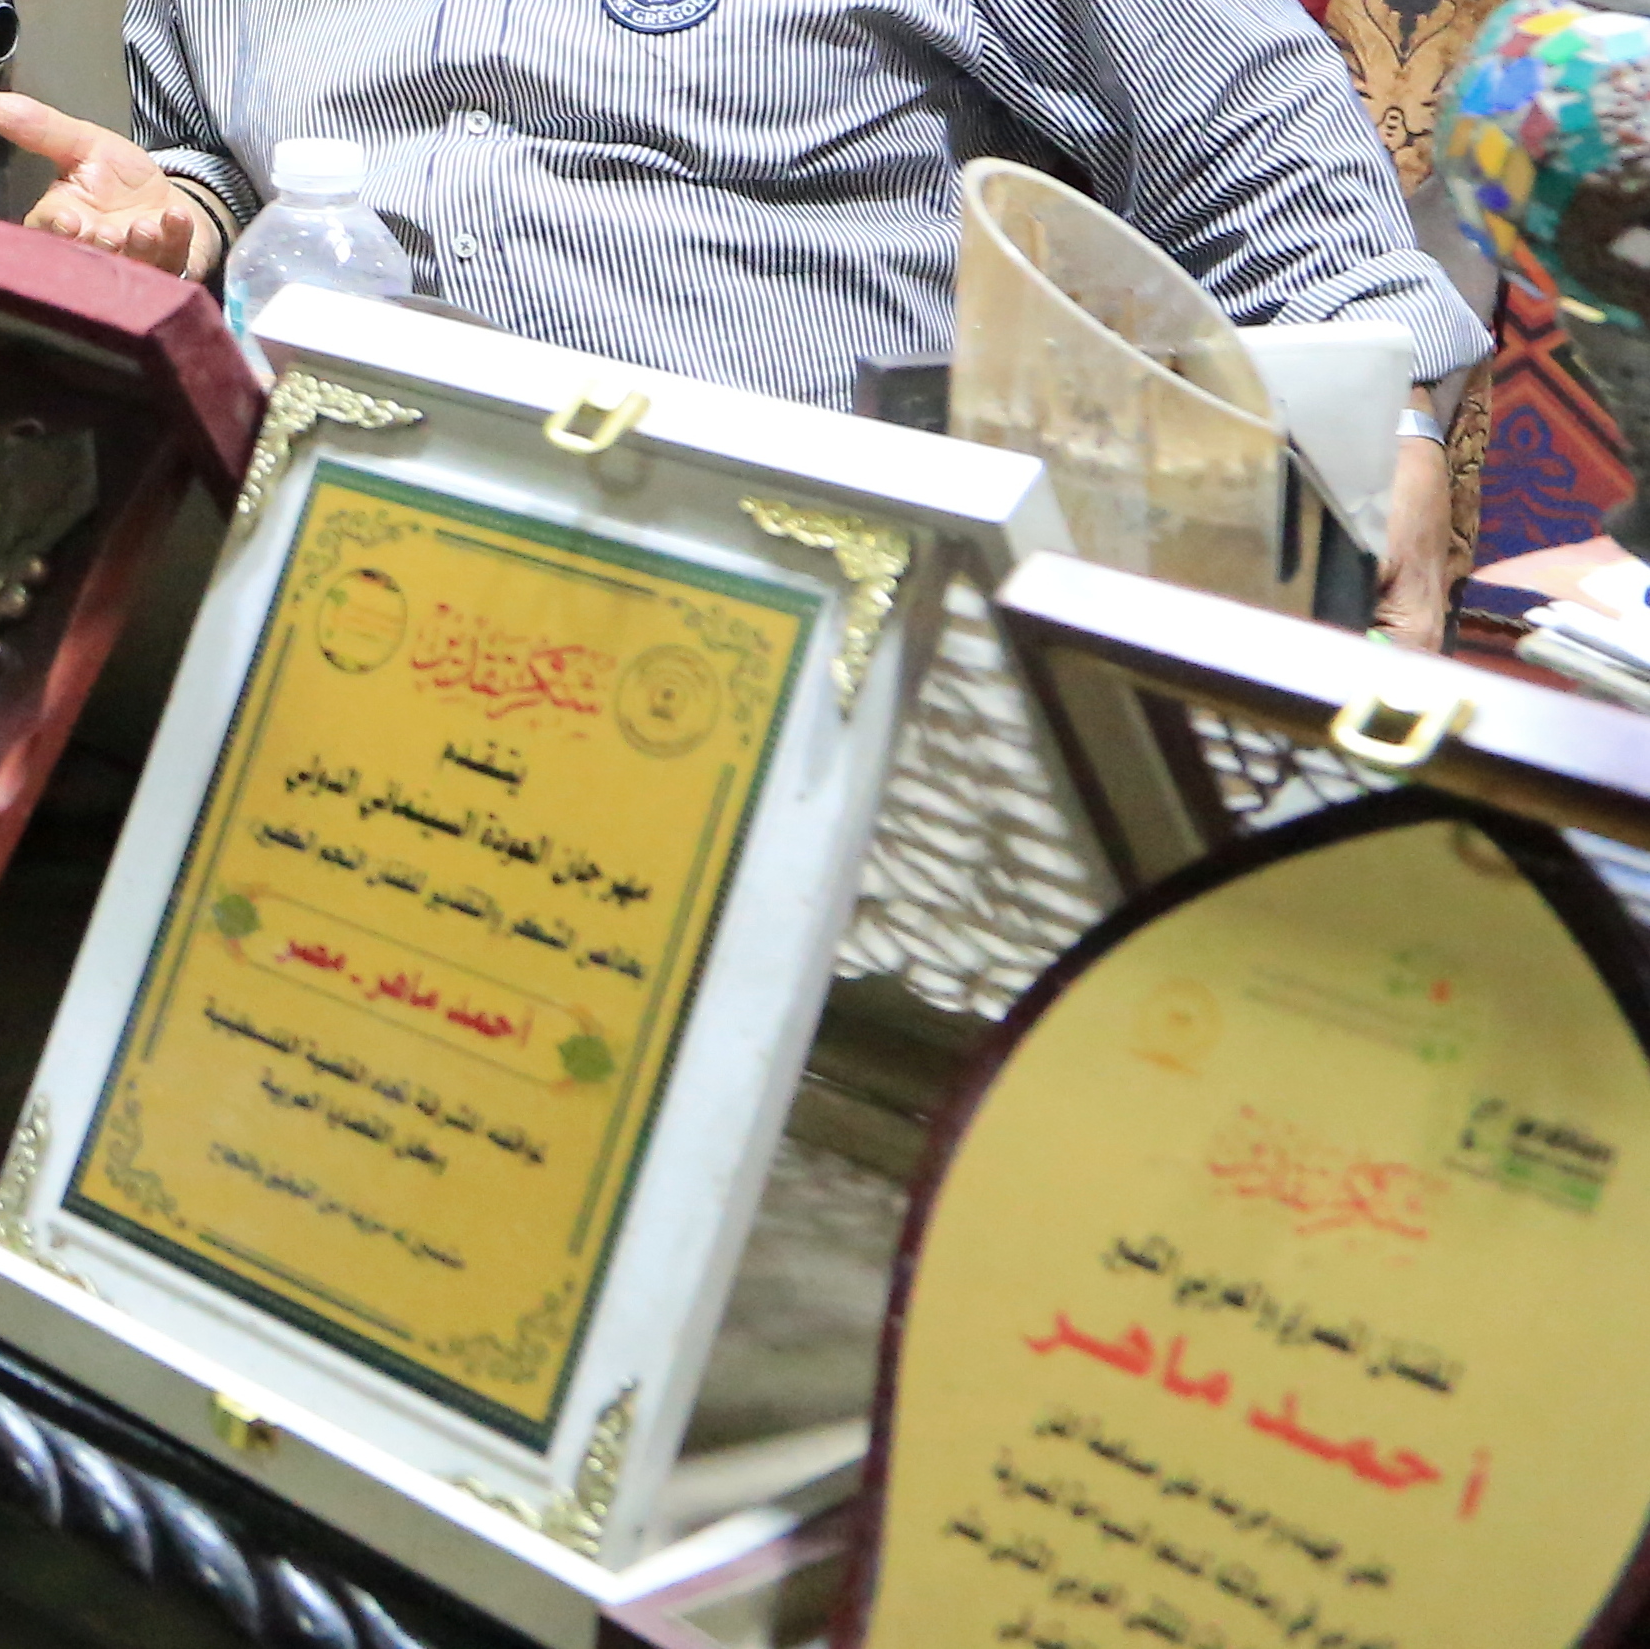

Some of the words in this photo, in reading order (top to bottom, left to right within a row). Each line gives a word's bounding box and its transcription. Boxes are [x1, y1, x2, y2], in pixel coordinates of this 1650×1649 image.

[550, 860, 651, 908] مهرجان
[274, 939, 347, 973] مصر
[363, 971, 440, 1011] ماهر
[1024, 1312, 1233, 1409] ماهر
